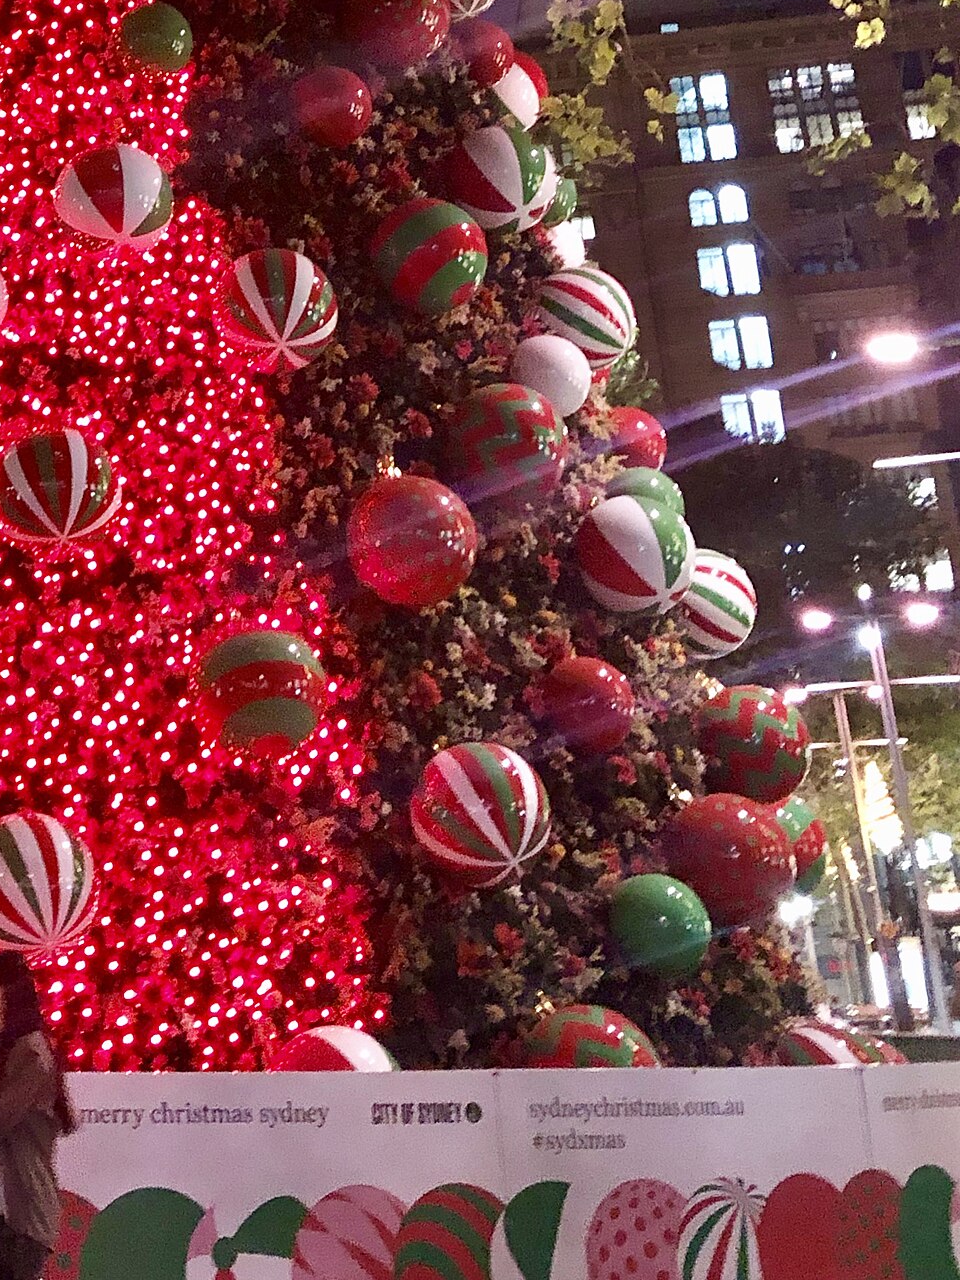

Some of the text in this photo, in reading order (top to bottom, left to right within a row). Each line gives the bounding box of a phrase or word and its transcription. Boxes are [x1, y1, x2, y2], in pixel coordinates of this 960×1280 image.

[78, 1100, 330, 1130] merry christmas sydney
[371, 1102, 398, 1125] CITY
[400, 1102, 414, 1124] OF
[528, 1096, 745, 1123] sydneychristmas.com.au
